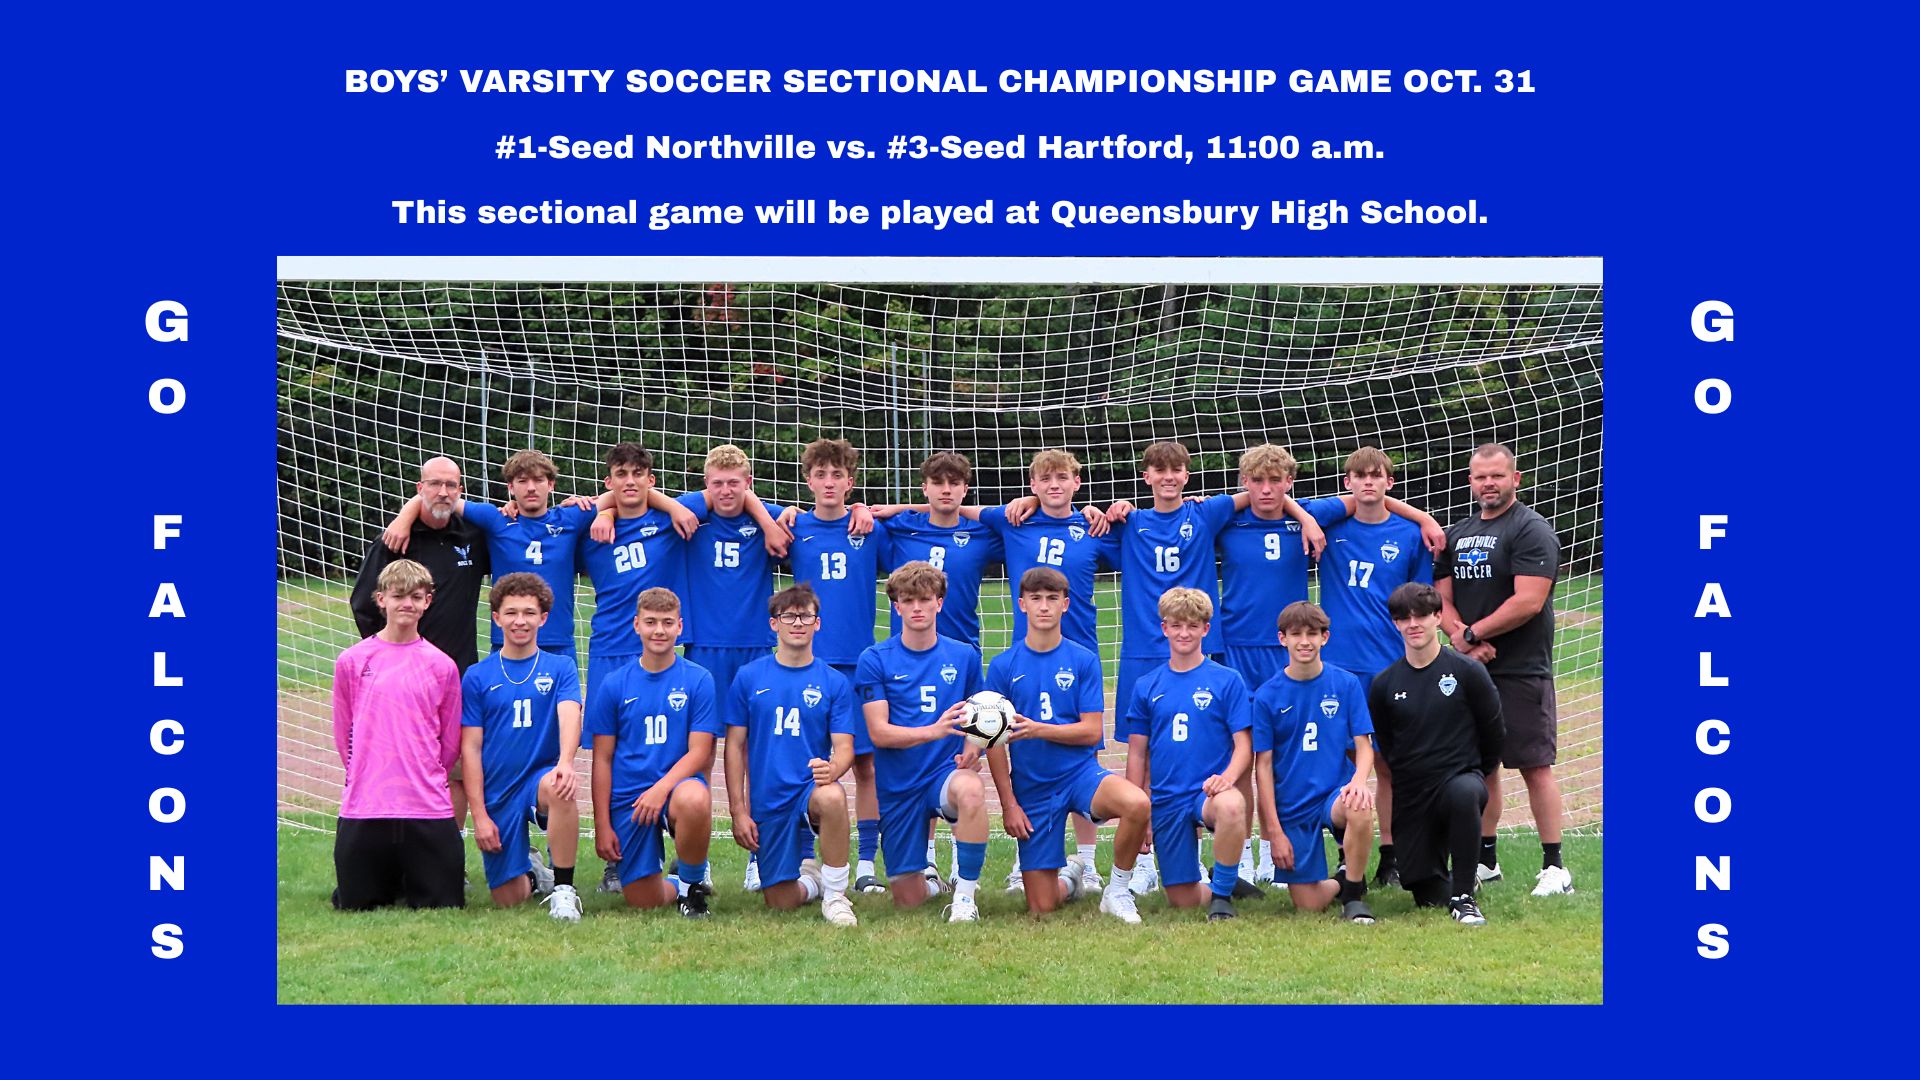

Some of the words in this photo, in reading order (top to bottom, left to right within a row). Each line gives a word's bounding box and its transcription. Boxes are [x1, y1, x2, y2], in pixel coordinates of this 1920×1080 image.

[525, 540, 543, 565] 4
[714, 541, 740, 568] 15
[1036, 536, 1065, 567] 12
[1264, 533, 1281, 561] 9
[1455, 535, 1498, 551] NORTHVILLE
[613, 541, 647, 574] 20
[821, 552, 847, 580] 13
[928, 546, 946, 571] 8
[1154, 546, 1181, 573] 16
[1454, 564, 1492, 579] SOCCER
[1347, 559, 1375, 589] 17
[512, 698, 533, 728] 11
[919, 685, 937, 713] 5
[1039, 691, 1053, 721] 3
[644, 714, 668, 745] 10
[773, 706, 800, 737] 14
[1172, 713, 1189, 742] 6
[1302, 722, 1318, 752] 2
